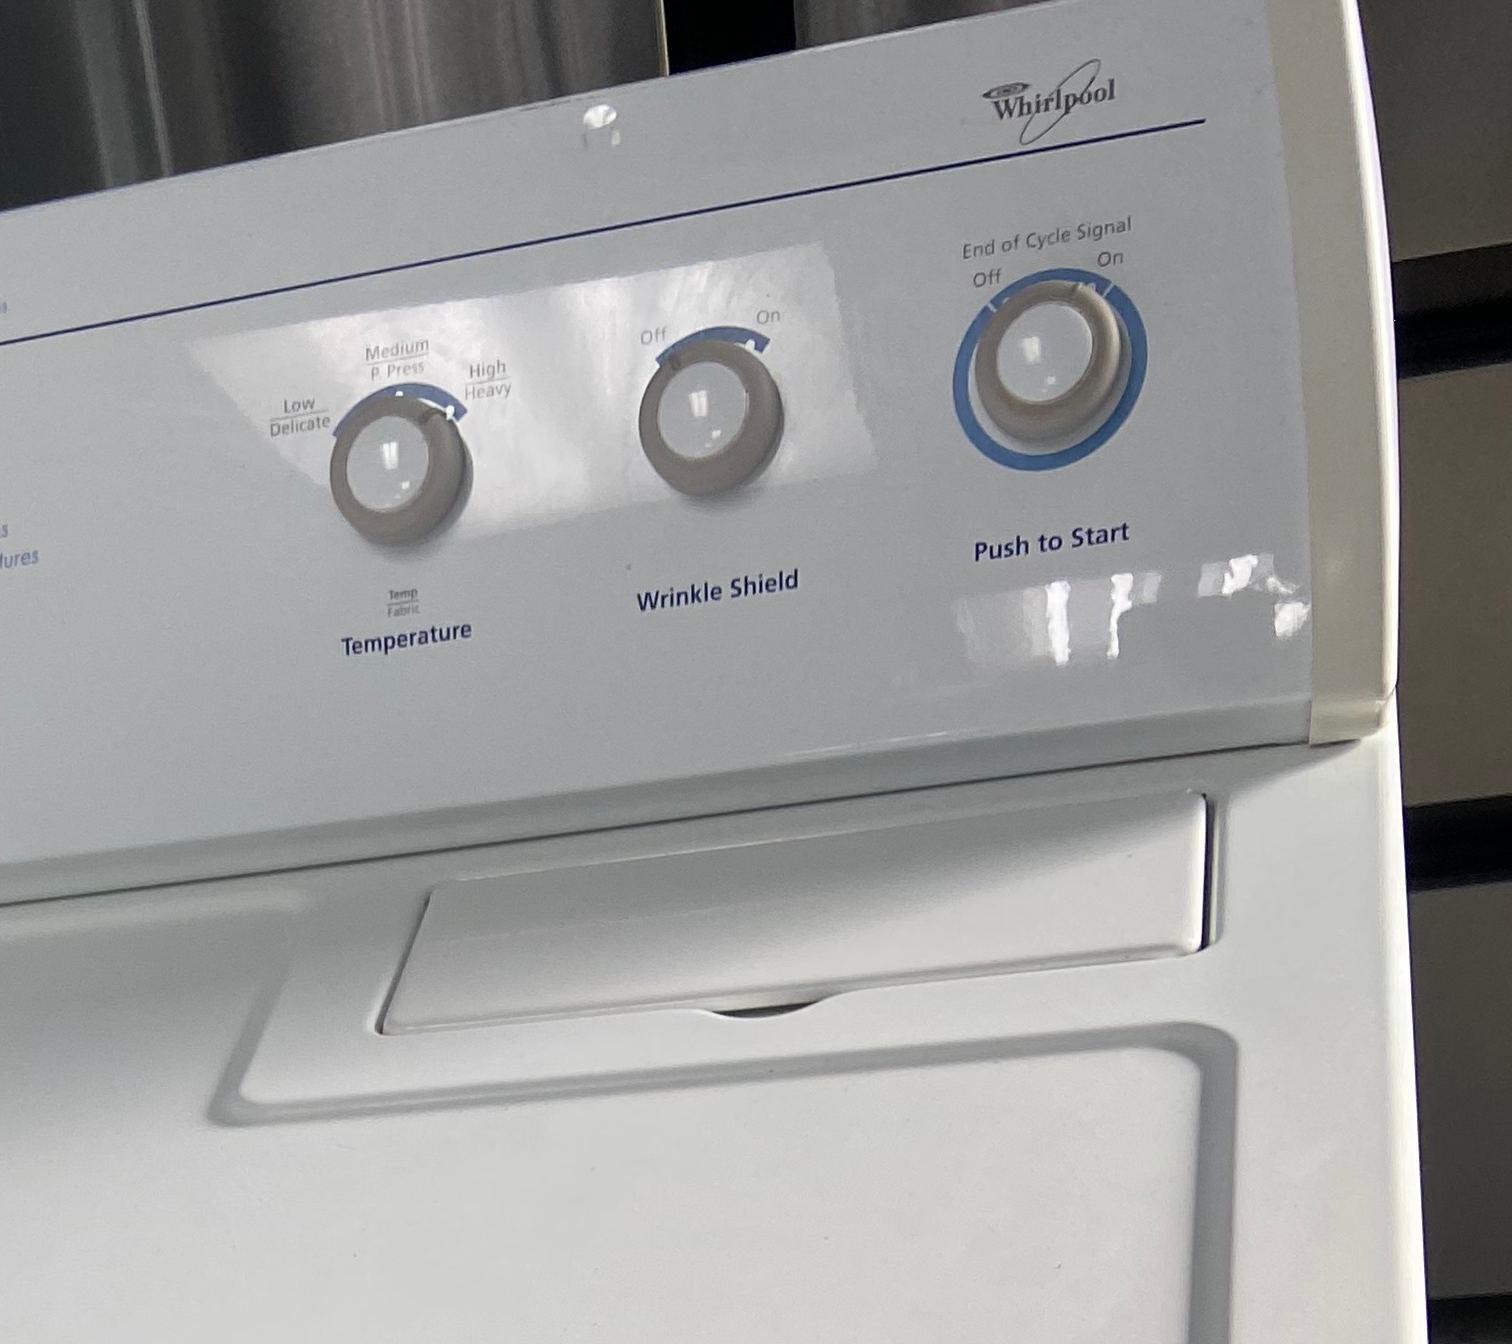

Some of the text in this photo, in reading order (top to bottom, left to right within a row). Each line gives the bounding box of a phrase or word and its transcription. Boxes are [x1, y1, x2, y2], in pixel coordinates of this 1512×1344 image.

[992, 78, 1116, 120] Whirlpool
[962, 215, 1133, 260] End of Cycle Signal
[1097, 251, 1124, 267] On
[973, 268, 1002, 288] Off
[756, 309, 781, 325] On
[640, 326, 667, 346] Off
[365, 340, 429, 361] Medium
[387, 362, 425, 378] Press
[469, 359, 506, 379] High
[465, 381, 512, 401] Heavy
[283, 397, 316, 414] Low
[270, 416, 331, 438] Delicate
[974, 522, 1130, 563] Push to Start
[636, 568, 799, 612] Wrinkle Shield
[340, 623, 472, 656] Temperature
